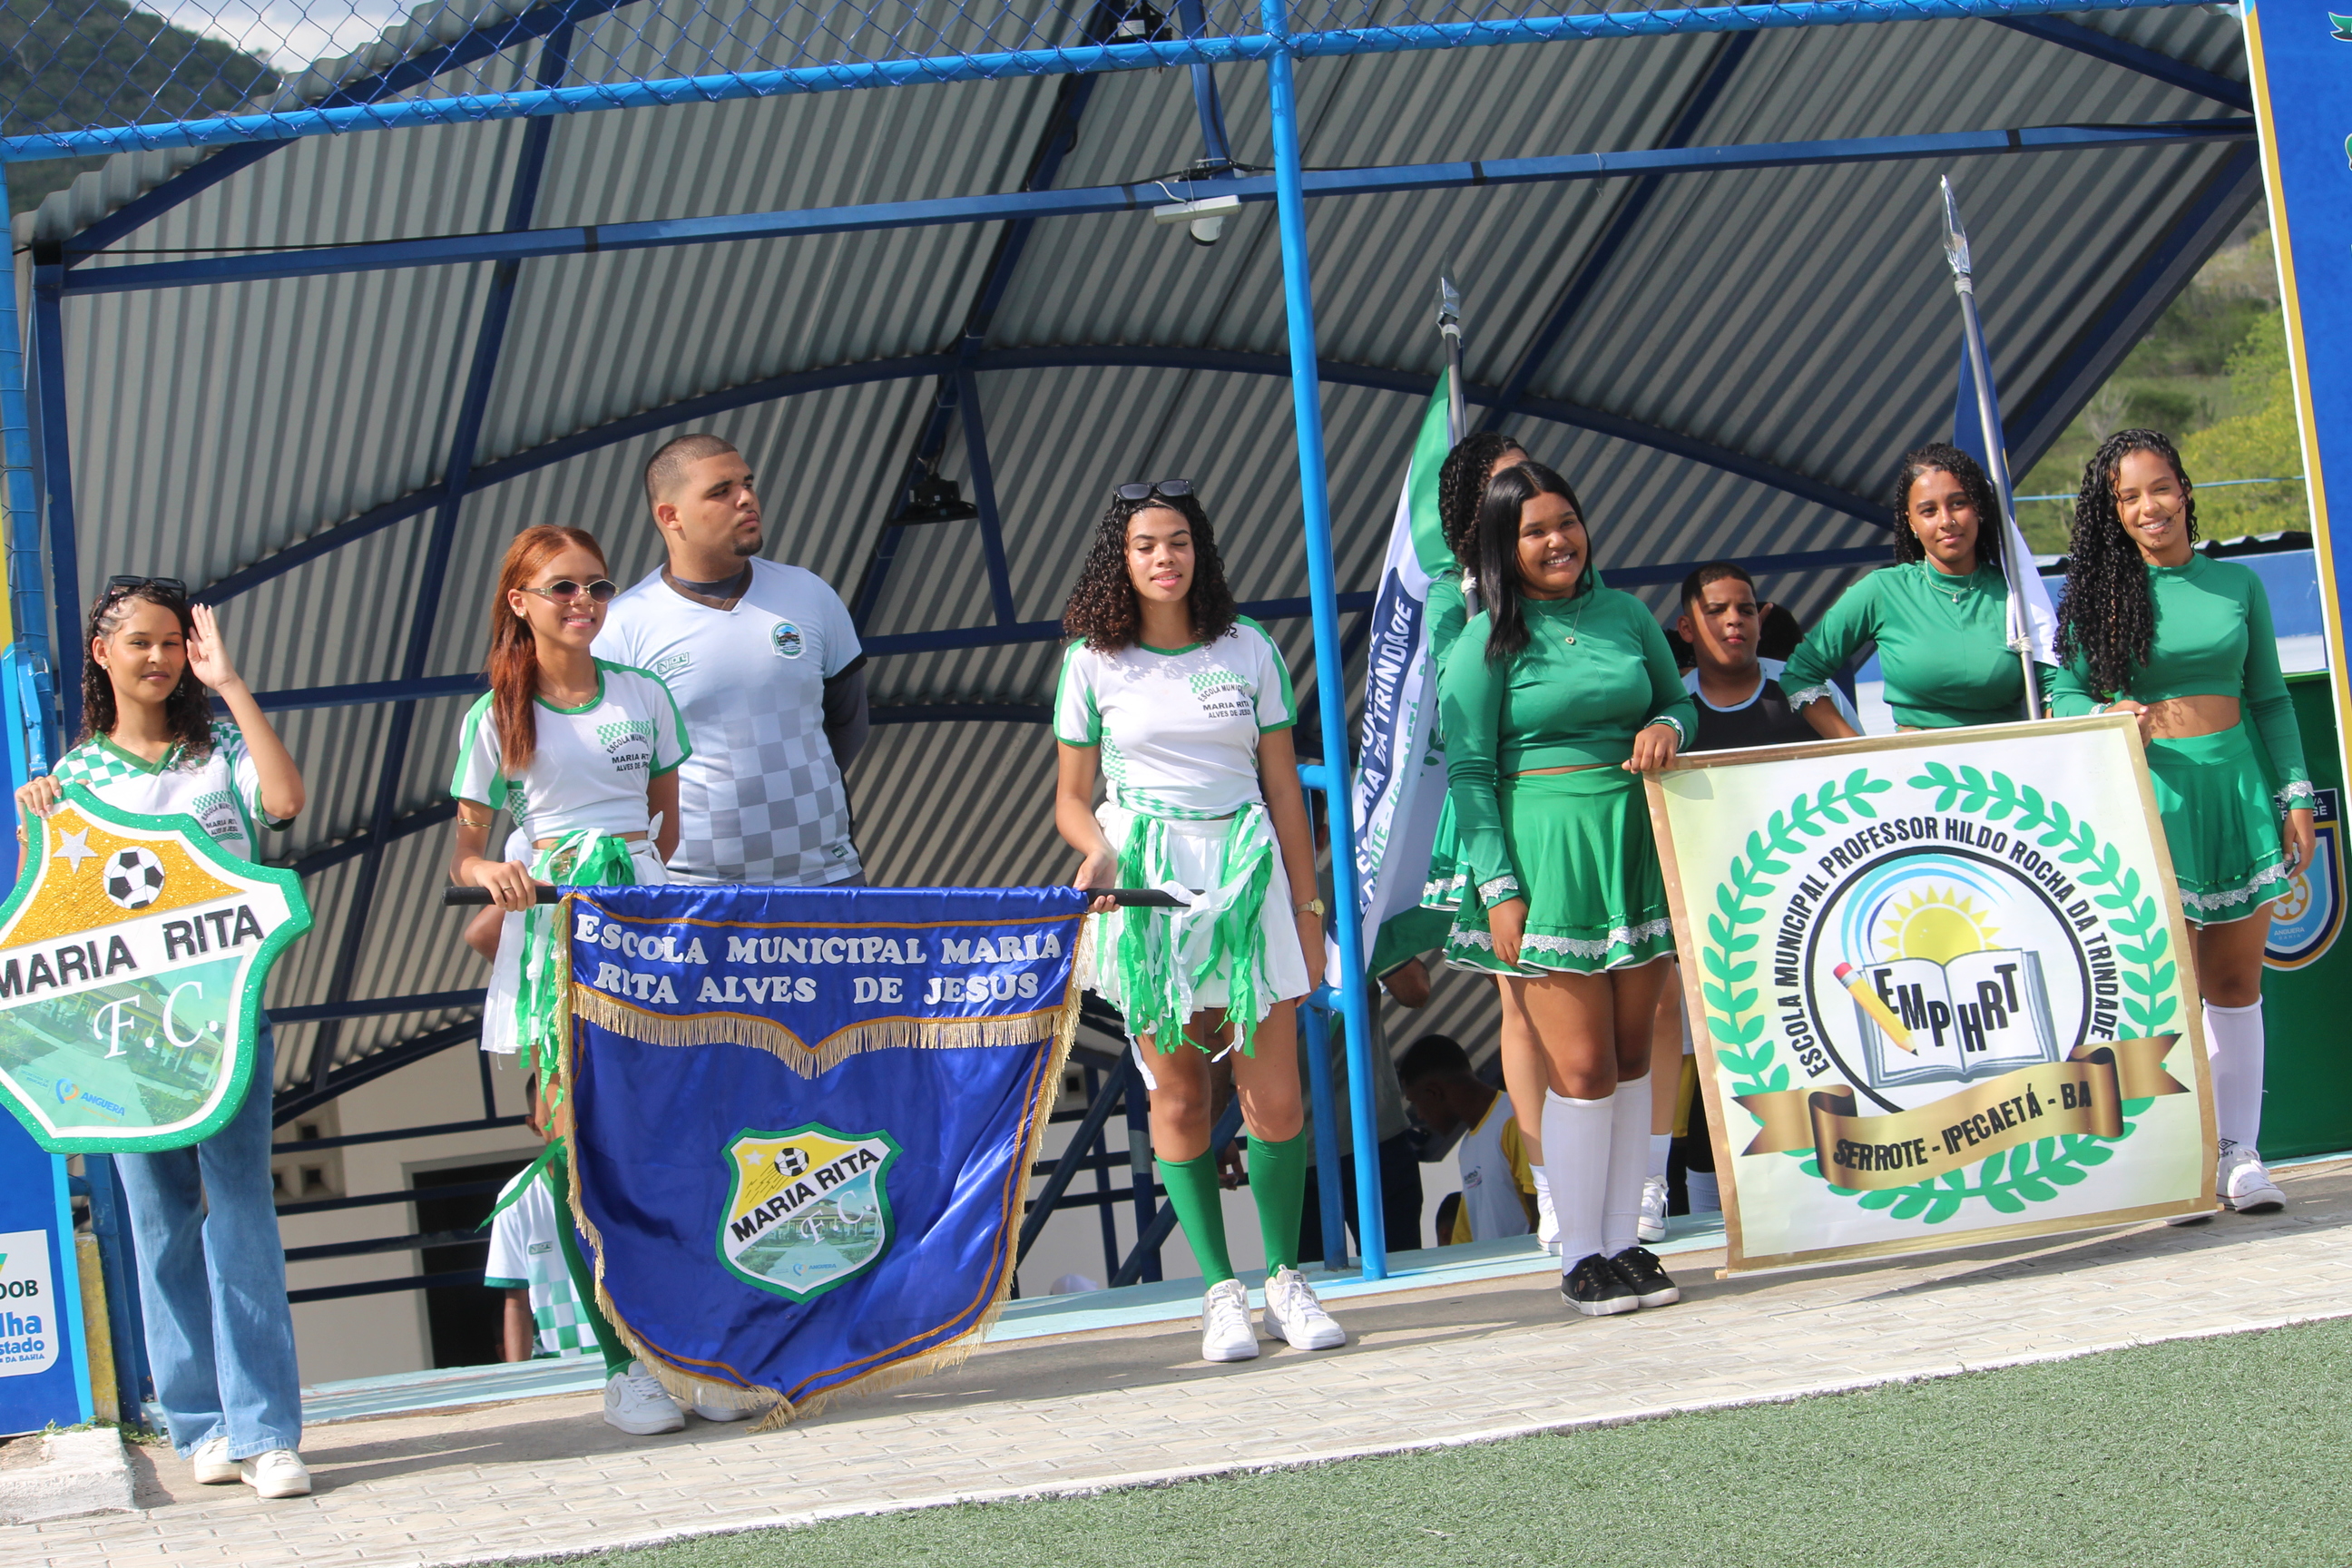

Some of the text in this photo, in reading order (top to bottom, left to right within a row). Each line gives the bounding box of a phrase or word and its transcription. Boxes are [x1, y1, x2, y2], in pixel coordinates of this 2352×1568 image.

[1374, 596, 1412, 723] TRINDADE
[1198, 686, 1221, 702] ESCOLA
[1202, 702, 1235, 710] MARIA
[1208, 710, 1229, 719] ALVES
[606, 736, 630, 754] ESCOLA
[612, 753, 640, 764] MARIA
[616, 763, 633, 772] ALVES
[573, 913, 1062, 965] ESCOLA MUNICIPAL MARIA
[2274, 926, 2305, 936] ANGUERA
[0, 905, 266, 998] MARIA RITA
[1775, 817, 2119, 1078] ESCOLA MUNICIPAL PROFESSOR HILDO ROCHA DA TRINDADE
[593, 962, 1038, 1004] RITA ALVES DE JESUS
[81, 1092, 125, 1116] ANGUERA
[1833, 1138, 1927, 1171] SERROTE
[1941, 1083, 2043, 1155] IPECAETÁ
[2061, 1081, 2092, 1110] BA
[730, 1148, 880, 1242] MARIA RITA
[19, 1353, 45, 1361] BAHIA
